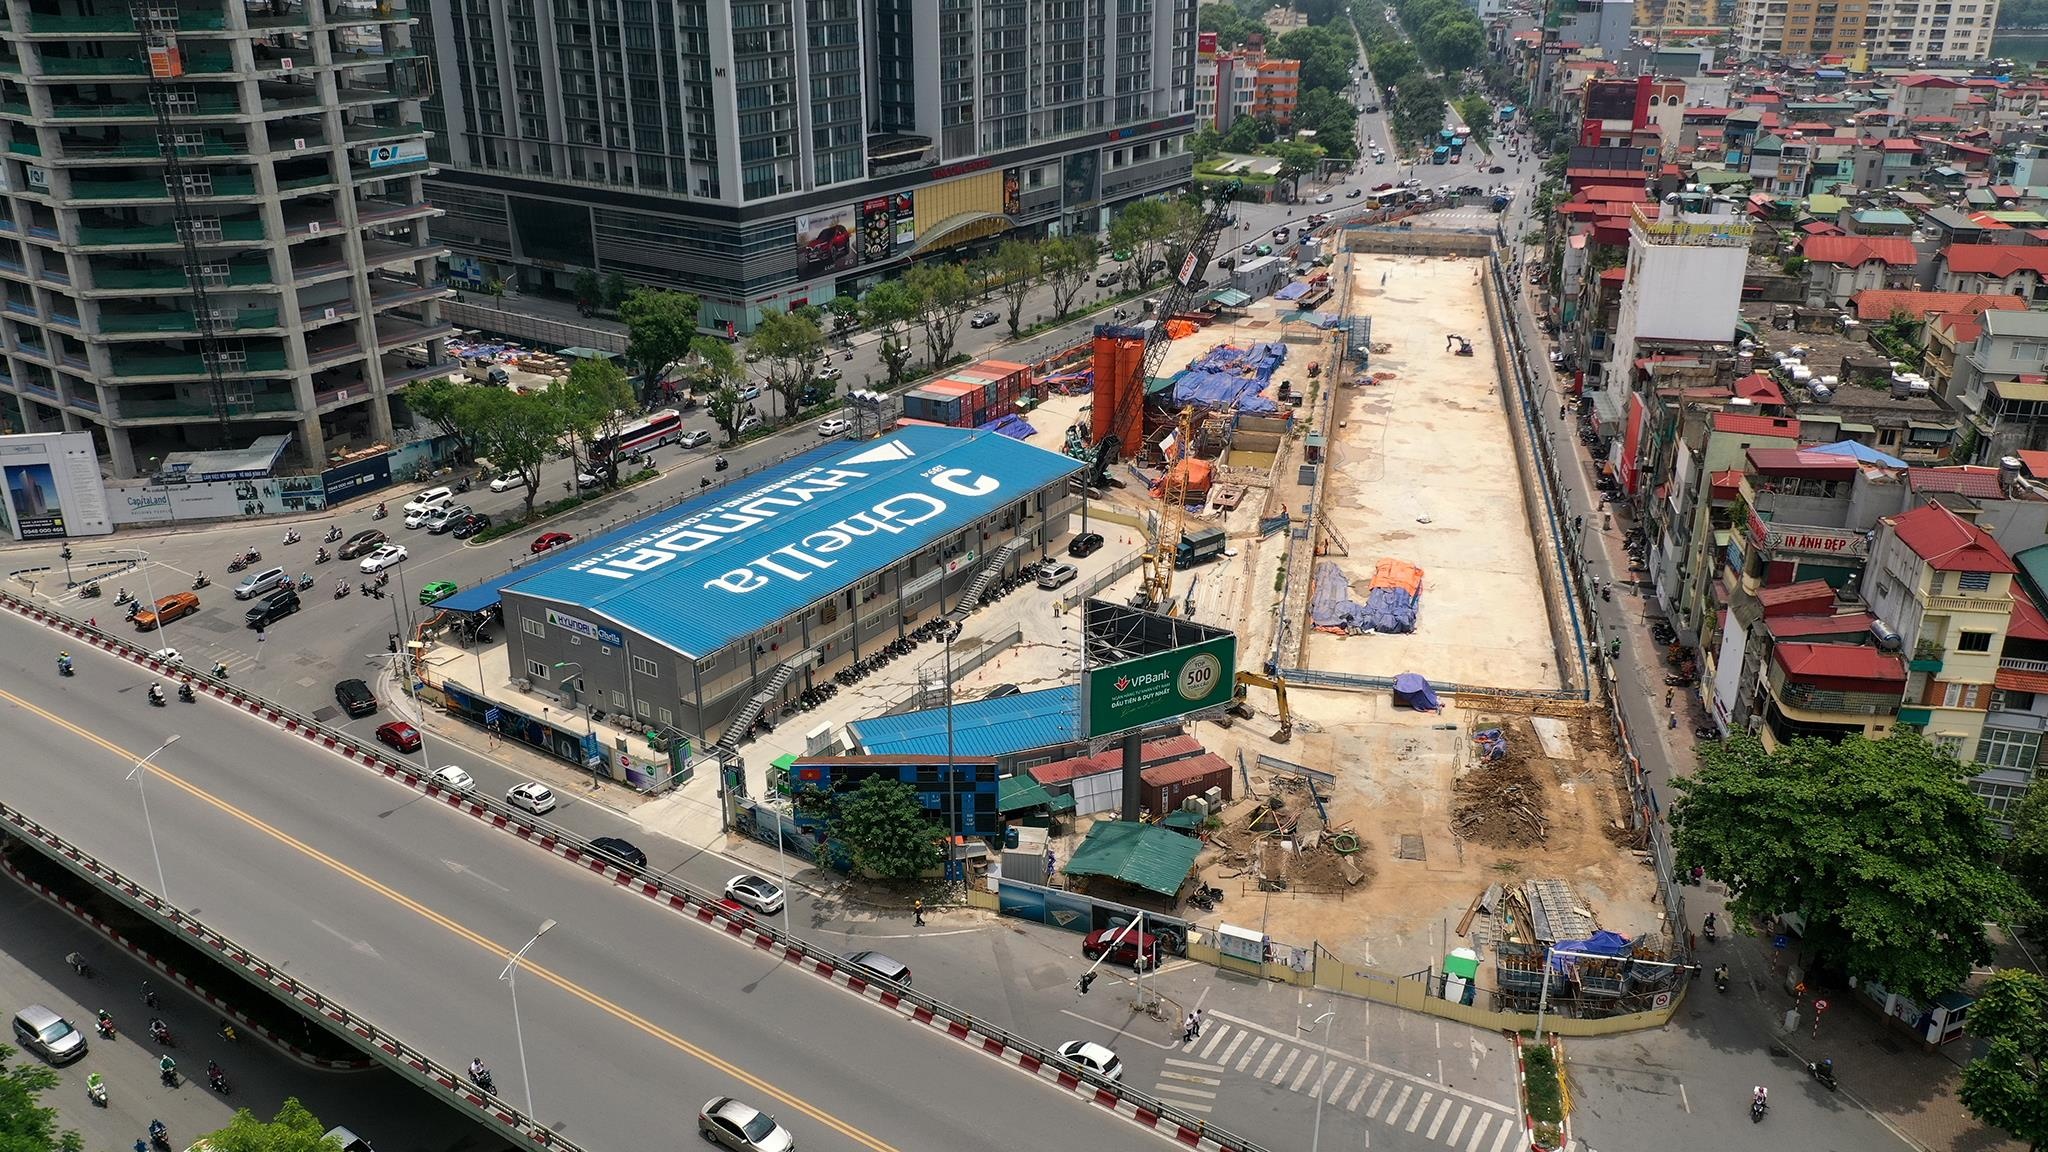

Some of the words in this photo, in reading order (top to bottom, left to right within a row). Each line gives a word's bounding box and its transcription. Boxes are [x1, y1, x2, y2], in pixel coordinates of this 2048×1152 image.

[715, 67, 725, 77] M1
[1180, 255, 1194, 281] FECON
[920, 464, 947, 478] 1894
[721, 467, 825, 508] ENGINEERING
[127, 495, 167, 507] CapitaLand
[586, 469, 870, 579] HYUNDAI
[568, 512, 713, 571] CONSTRUCTION
[703, 492, 947, 593] Ghella
[1784, 535, 1796, 547] IN
[1798, 534, 1822, 549] ẢNH
[1824, 539, 1847, 552] ĐẸP
[557, 615, 591, 633] HYUNDAI
[598, 629, 620, 643] Ghella
[1195, 660, 1206, 668] TOP
[1131, 669, 1170, 688] VPBank
[1187, 667, 1211, 685] 500
[1124, 697, 1137, 705] TIÊN
[1142, 692, 1154, 700] DUY
[1155, 688, 1170, 697] NHẤT
